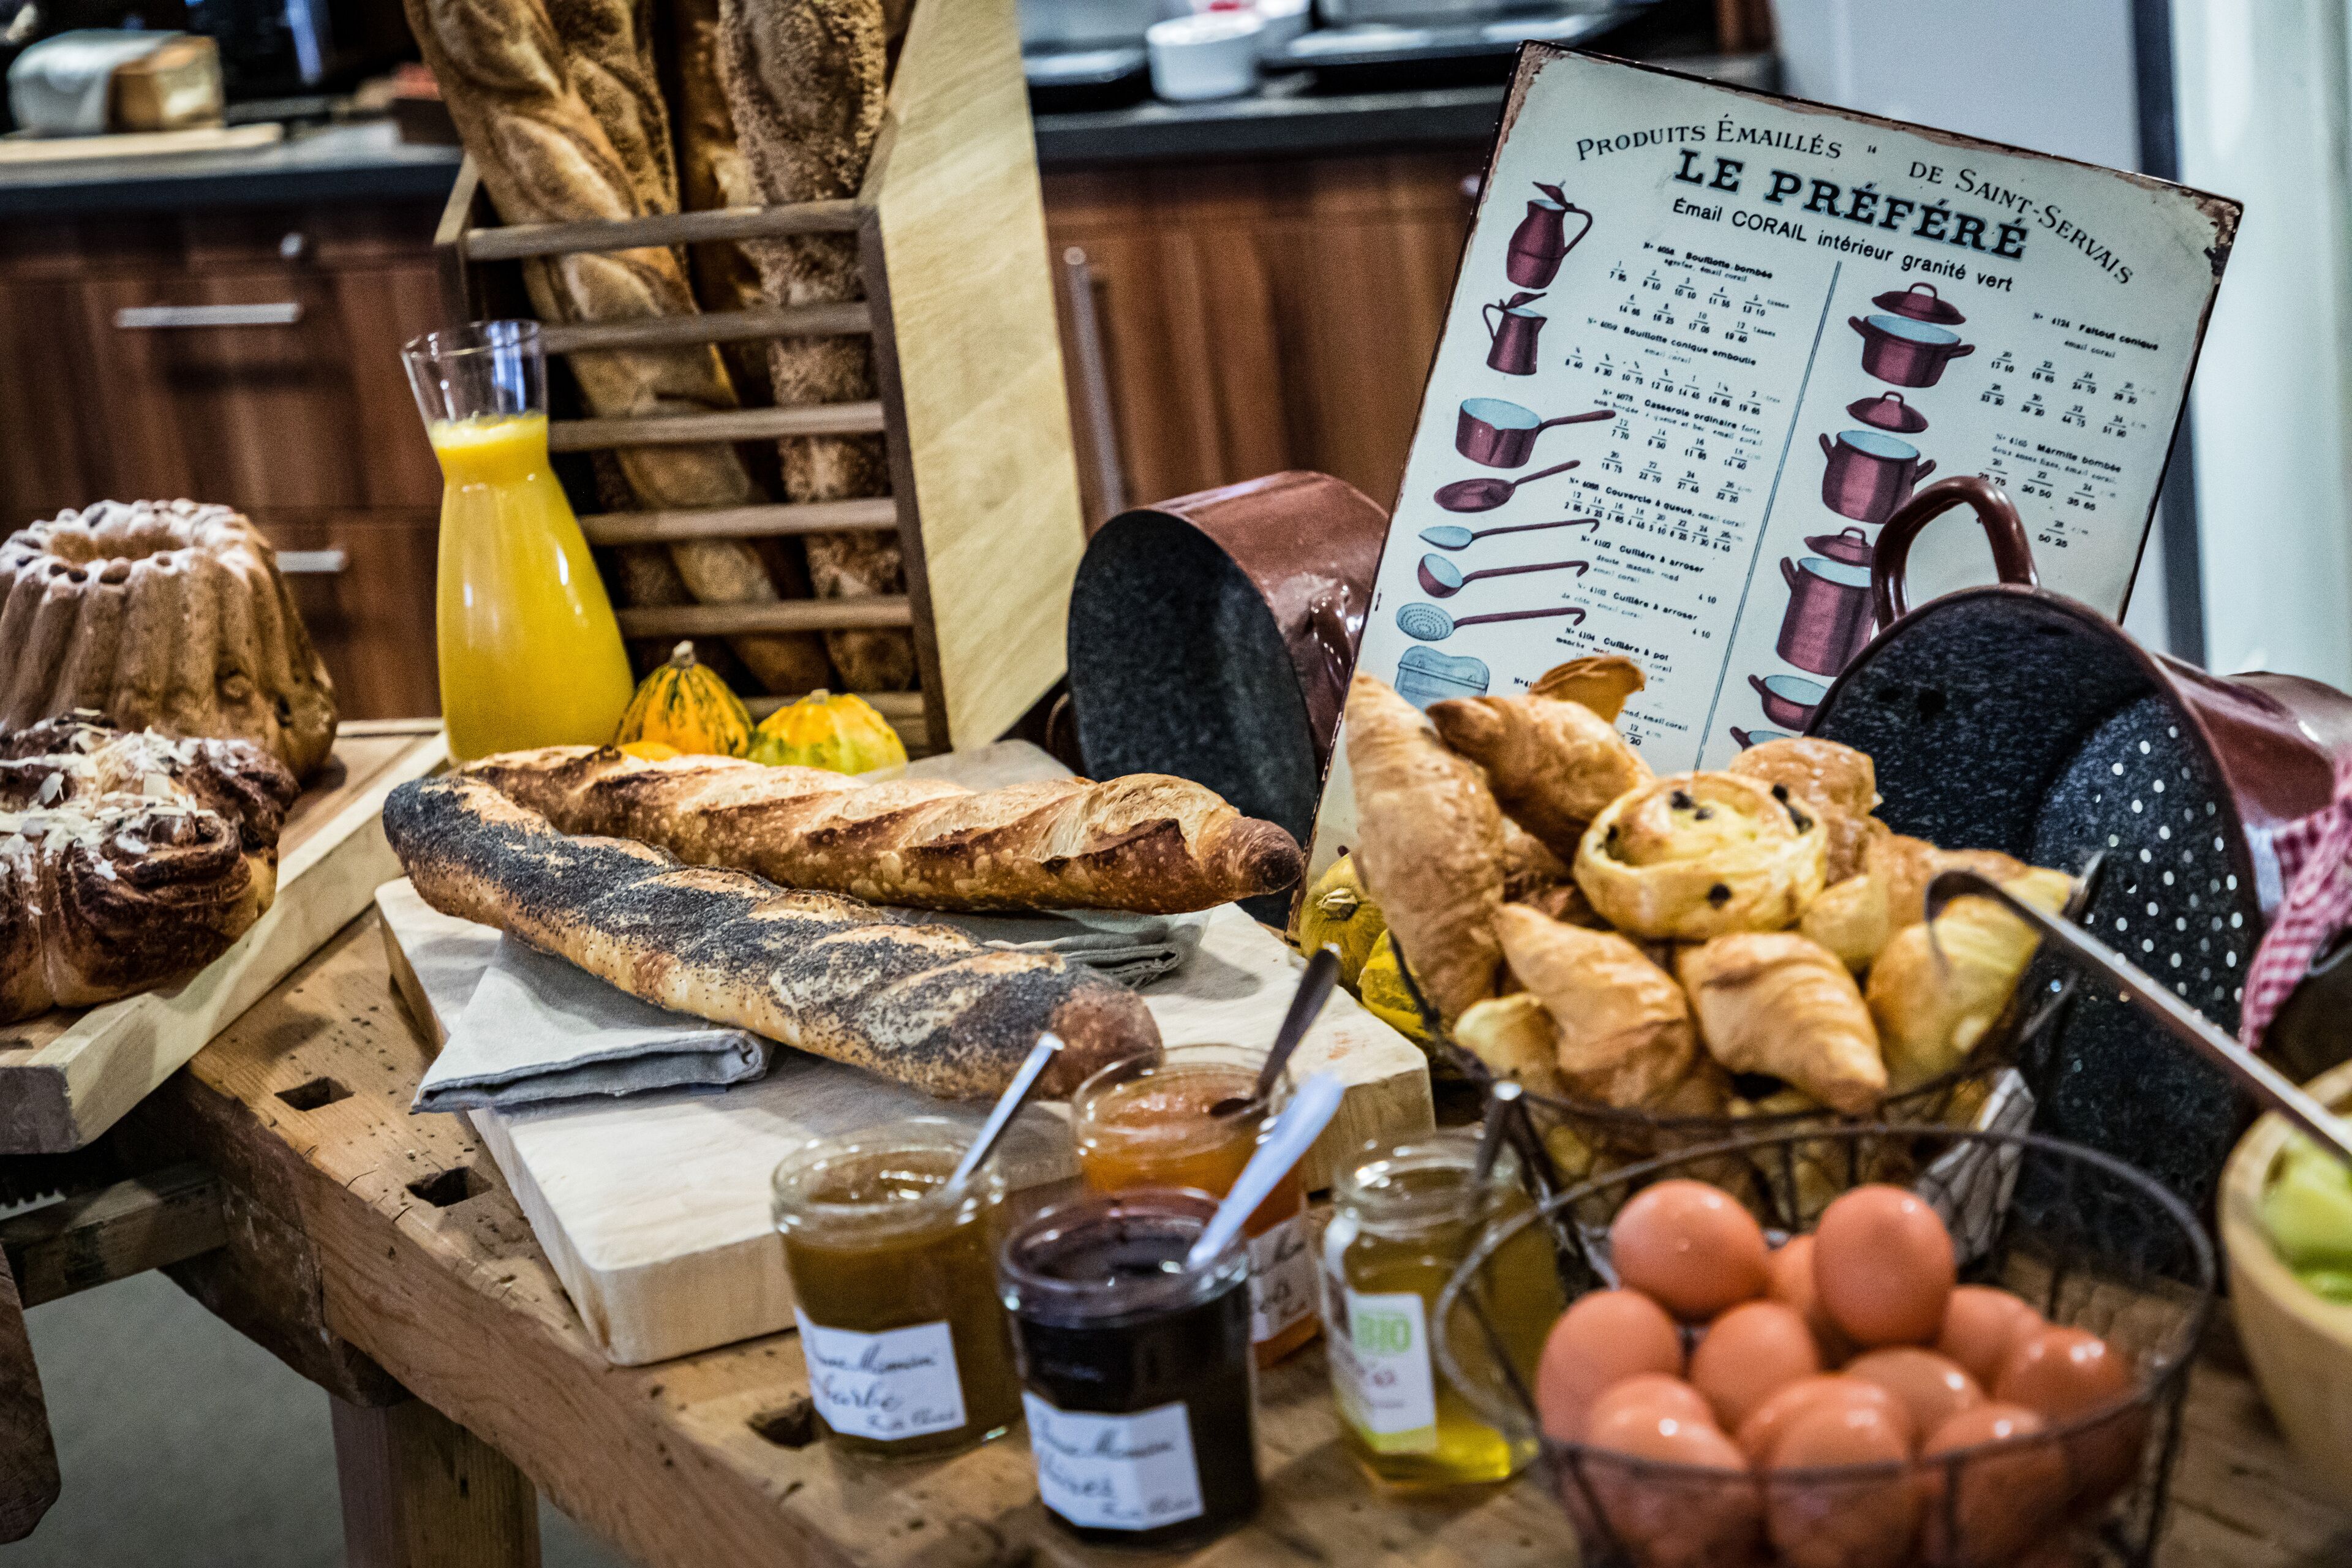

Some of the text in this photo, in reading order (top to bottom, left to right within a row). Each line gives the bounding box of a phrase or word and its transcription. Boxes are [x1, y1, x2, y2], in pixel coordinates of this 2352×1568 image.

[1577, 113, 2135, 285] PRODUITS ÉMAILLÉS DE SAINT-SERVAIS
[1673, 147, 2030, 262] LE PRÉFÉRÉ
[1673, 197, 2013, 292] Émail CORAIL intérieur granité vert
[1624, 326, 1667, 344] Bouillotte
[1671, 340, 1708, 353] conique
[1645, 399, 1689, 417] Casserole
[1693, 413, 1737, 431] ordinaire
[1605, 487, 1651, 505] Couvercle
[2039, 489, 2052, 499] 50
[1670, 560, 1704, 572] arroser
[1663, 607, 1697, 620] arroser
